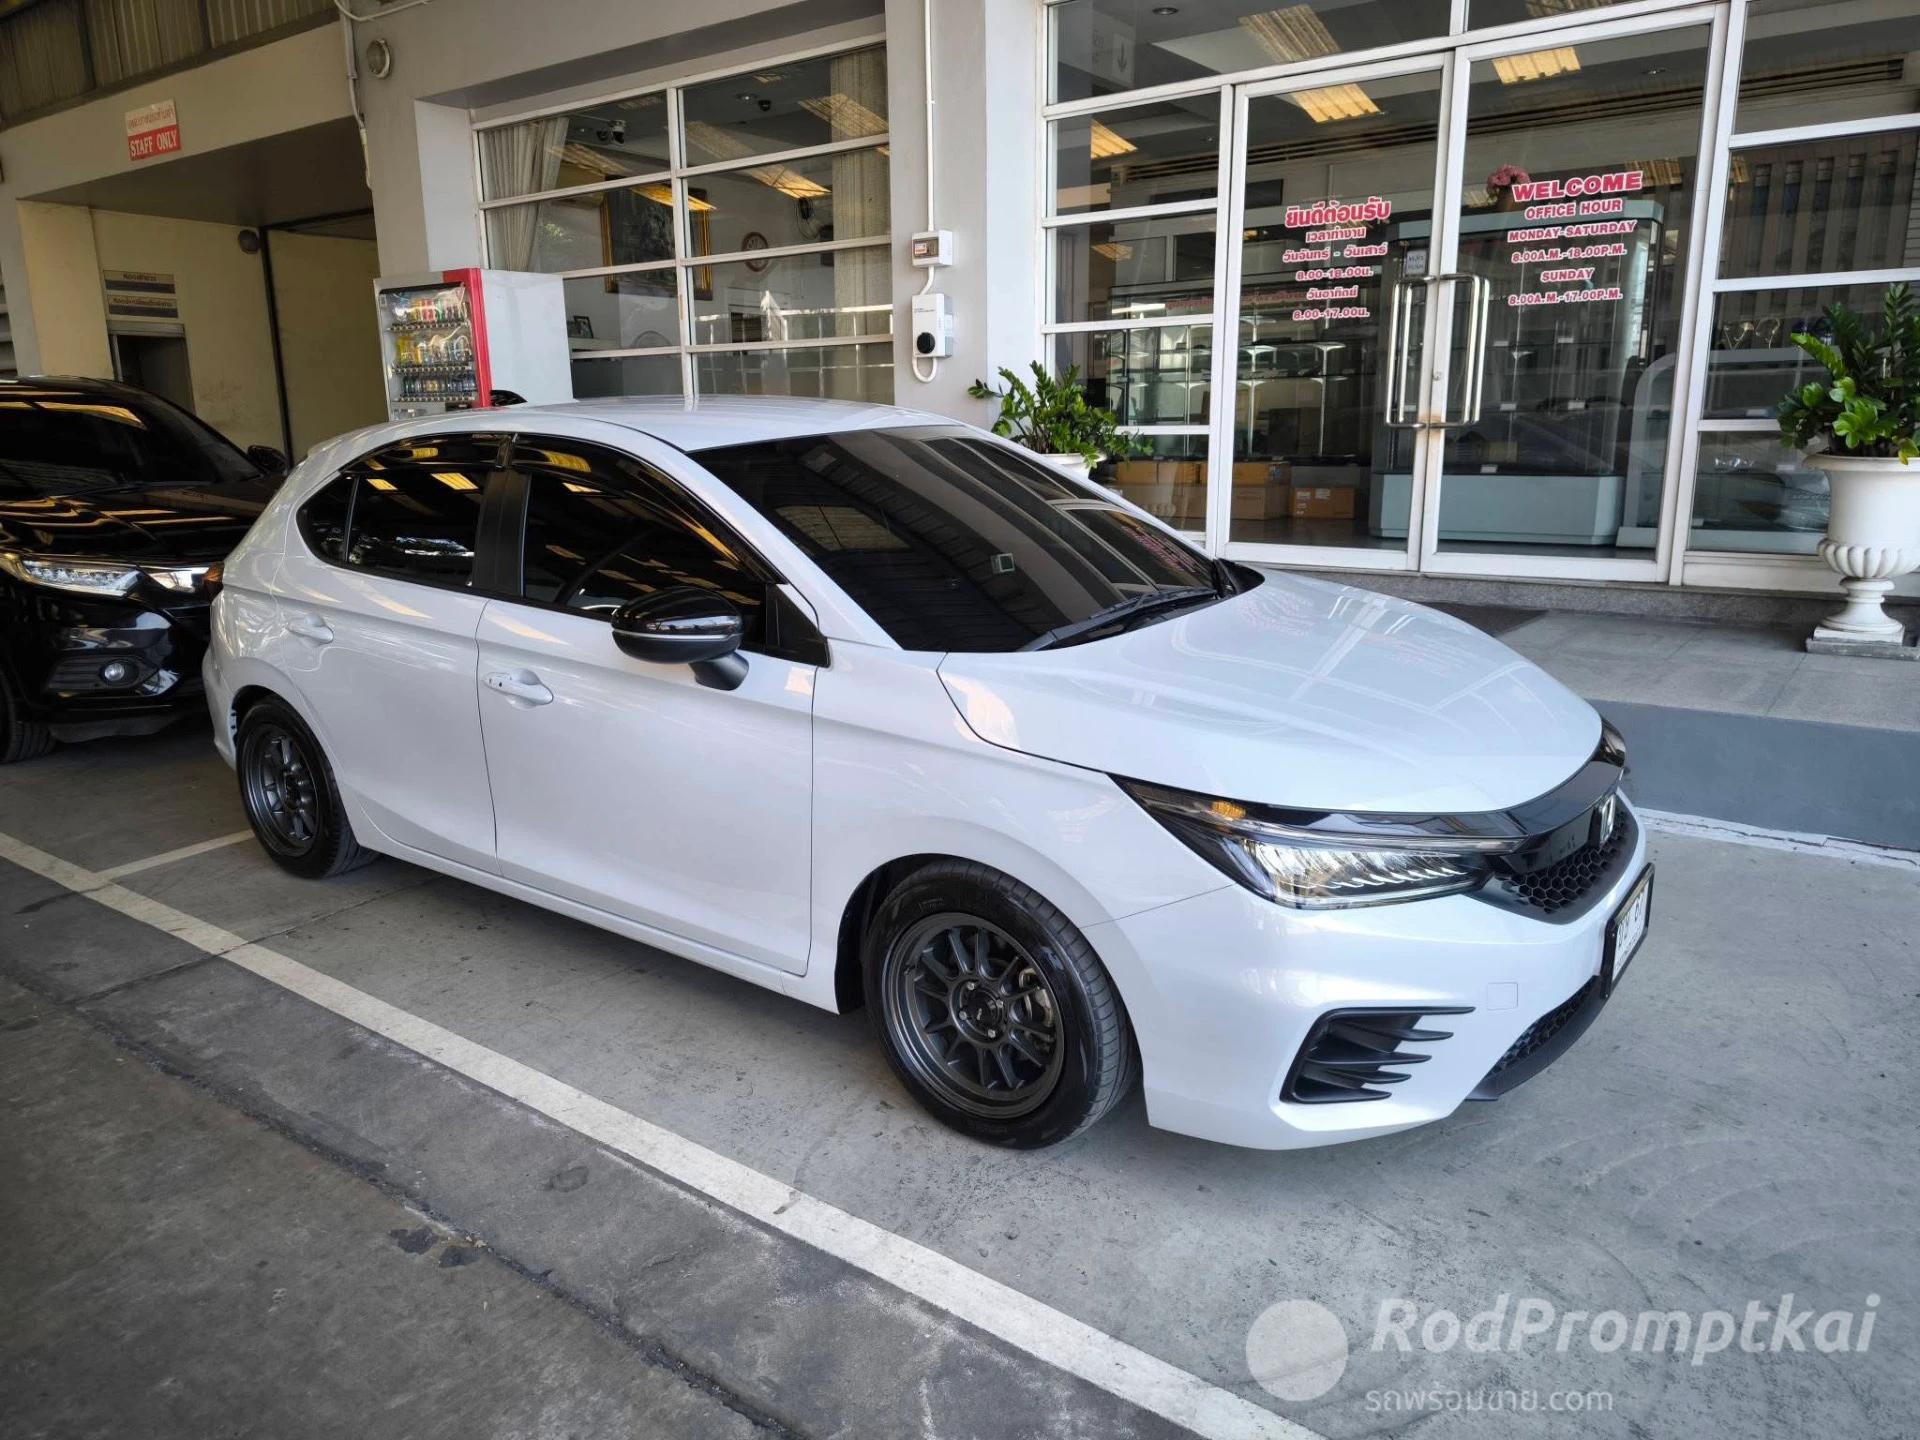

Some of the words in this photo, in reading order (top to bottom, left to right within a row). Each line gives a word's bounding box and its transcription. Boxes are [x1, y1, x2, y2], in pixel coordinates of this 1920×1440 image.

[130, 136, 153, 156] STAFF
[156, 130, 177, 150] ONLY
[1512, 170, 1643, 202] WELCOME
[1284, 196, 1392, 228] ยินดีต้อนรับ
[1525, 203, 1576, 220] OFFICE
[1580, 198, 1622, 216] HOUR
[1306, 226, 1367, 243] เวลาทำงาน
[1282, 246, 1331, 262] วันจันทร์
[1343, 242, 1388, 258] วันเสาร์
[1540, 267, 1595, 282] SUNDAY
[1306, 285, 1359, 300] วันอาทิตย์
